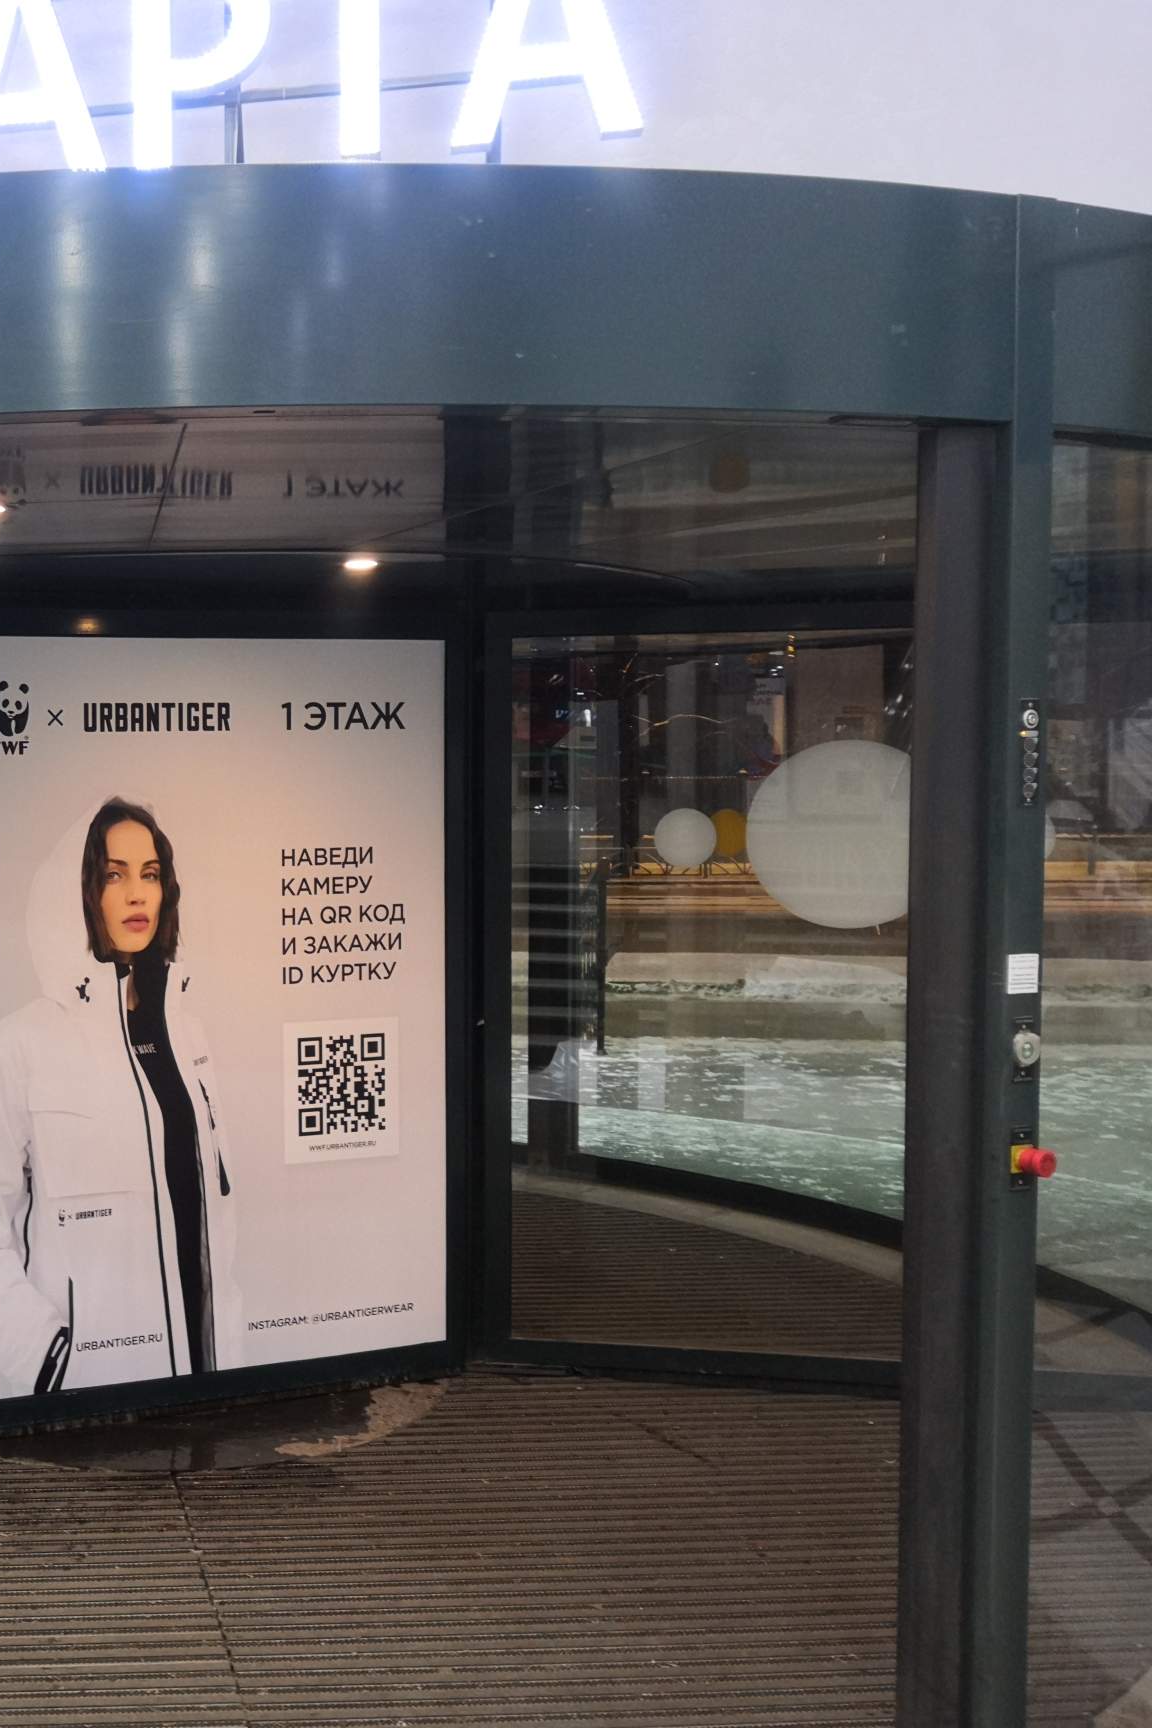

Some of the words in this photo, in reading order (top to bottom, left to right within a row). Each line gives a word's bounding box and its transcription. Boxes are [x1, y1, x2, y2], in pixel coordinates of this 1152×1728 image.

[83, 702, 231, 732] URBANTIGER
[281, 701, 292, 730] 1
[303, 701, 406, 731] ЭТАЖ
[281, 846, 374, 868] НАВЕДИ
[281, 875, 373, 896] КАМЕРУ
[281, 907, 313, 926] НА
[320, 905, 352, 924] QR
[359, 903, 406, 925] КОД
[282, 937, 296, 955] И
[303, 932, 402, 954] ЗАКАЖИ
[282, 966, 303, 984] ID
[311, 961, 397, 983] КУРТКУ
[248, 1315, 308, 1331] INSTAGRAM:
[312, 1302, 415, 1324] @URBANTIGERWEAR
[76, 1333, 163, 1352] URBANTIGER.RU
